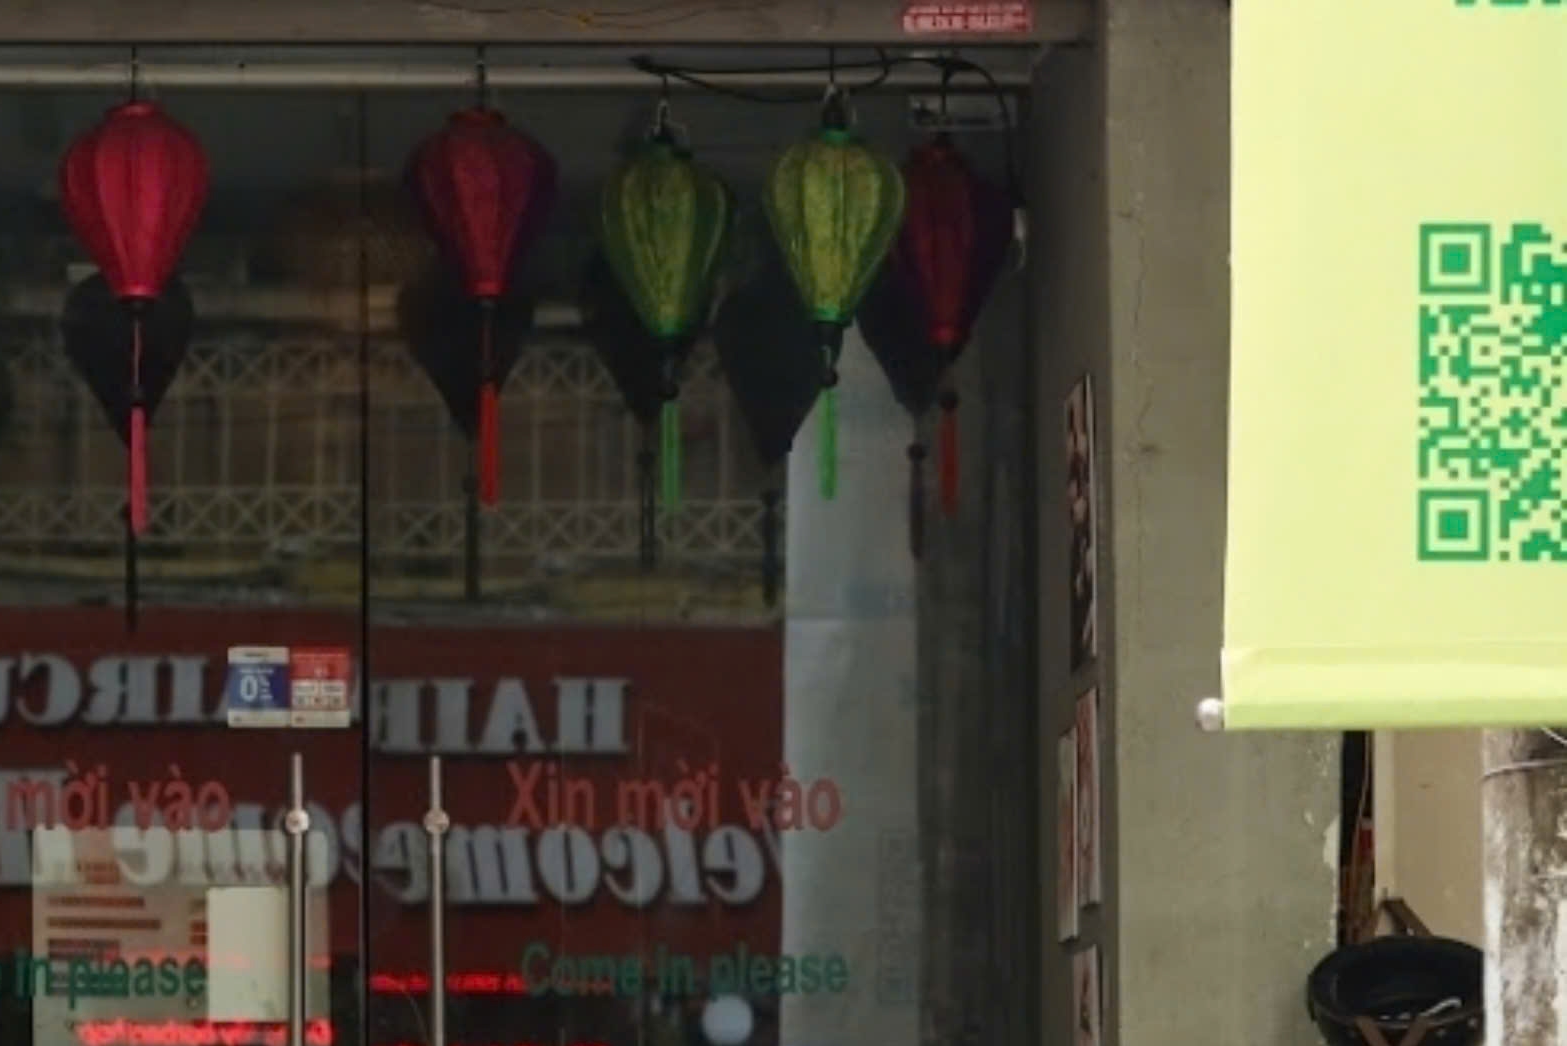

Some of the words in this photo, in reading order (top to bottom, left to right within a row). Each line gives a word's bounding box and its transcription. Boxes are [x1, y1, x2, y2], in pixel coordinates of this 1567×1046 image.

[6, 759, 109, 831] mời
[128, 763, 230, 832] vào
[507, 762, 594, 830] Xin
[618, 760, 719, 831] mời
[17, 944, 52, 997] in
[522, 942, 643, 997] Come
[657, 943, 696, 996] in
[709, 943, 848, 1005] please
